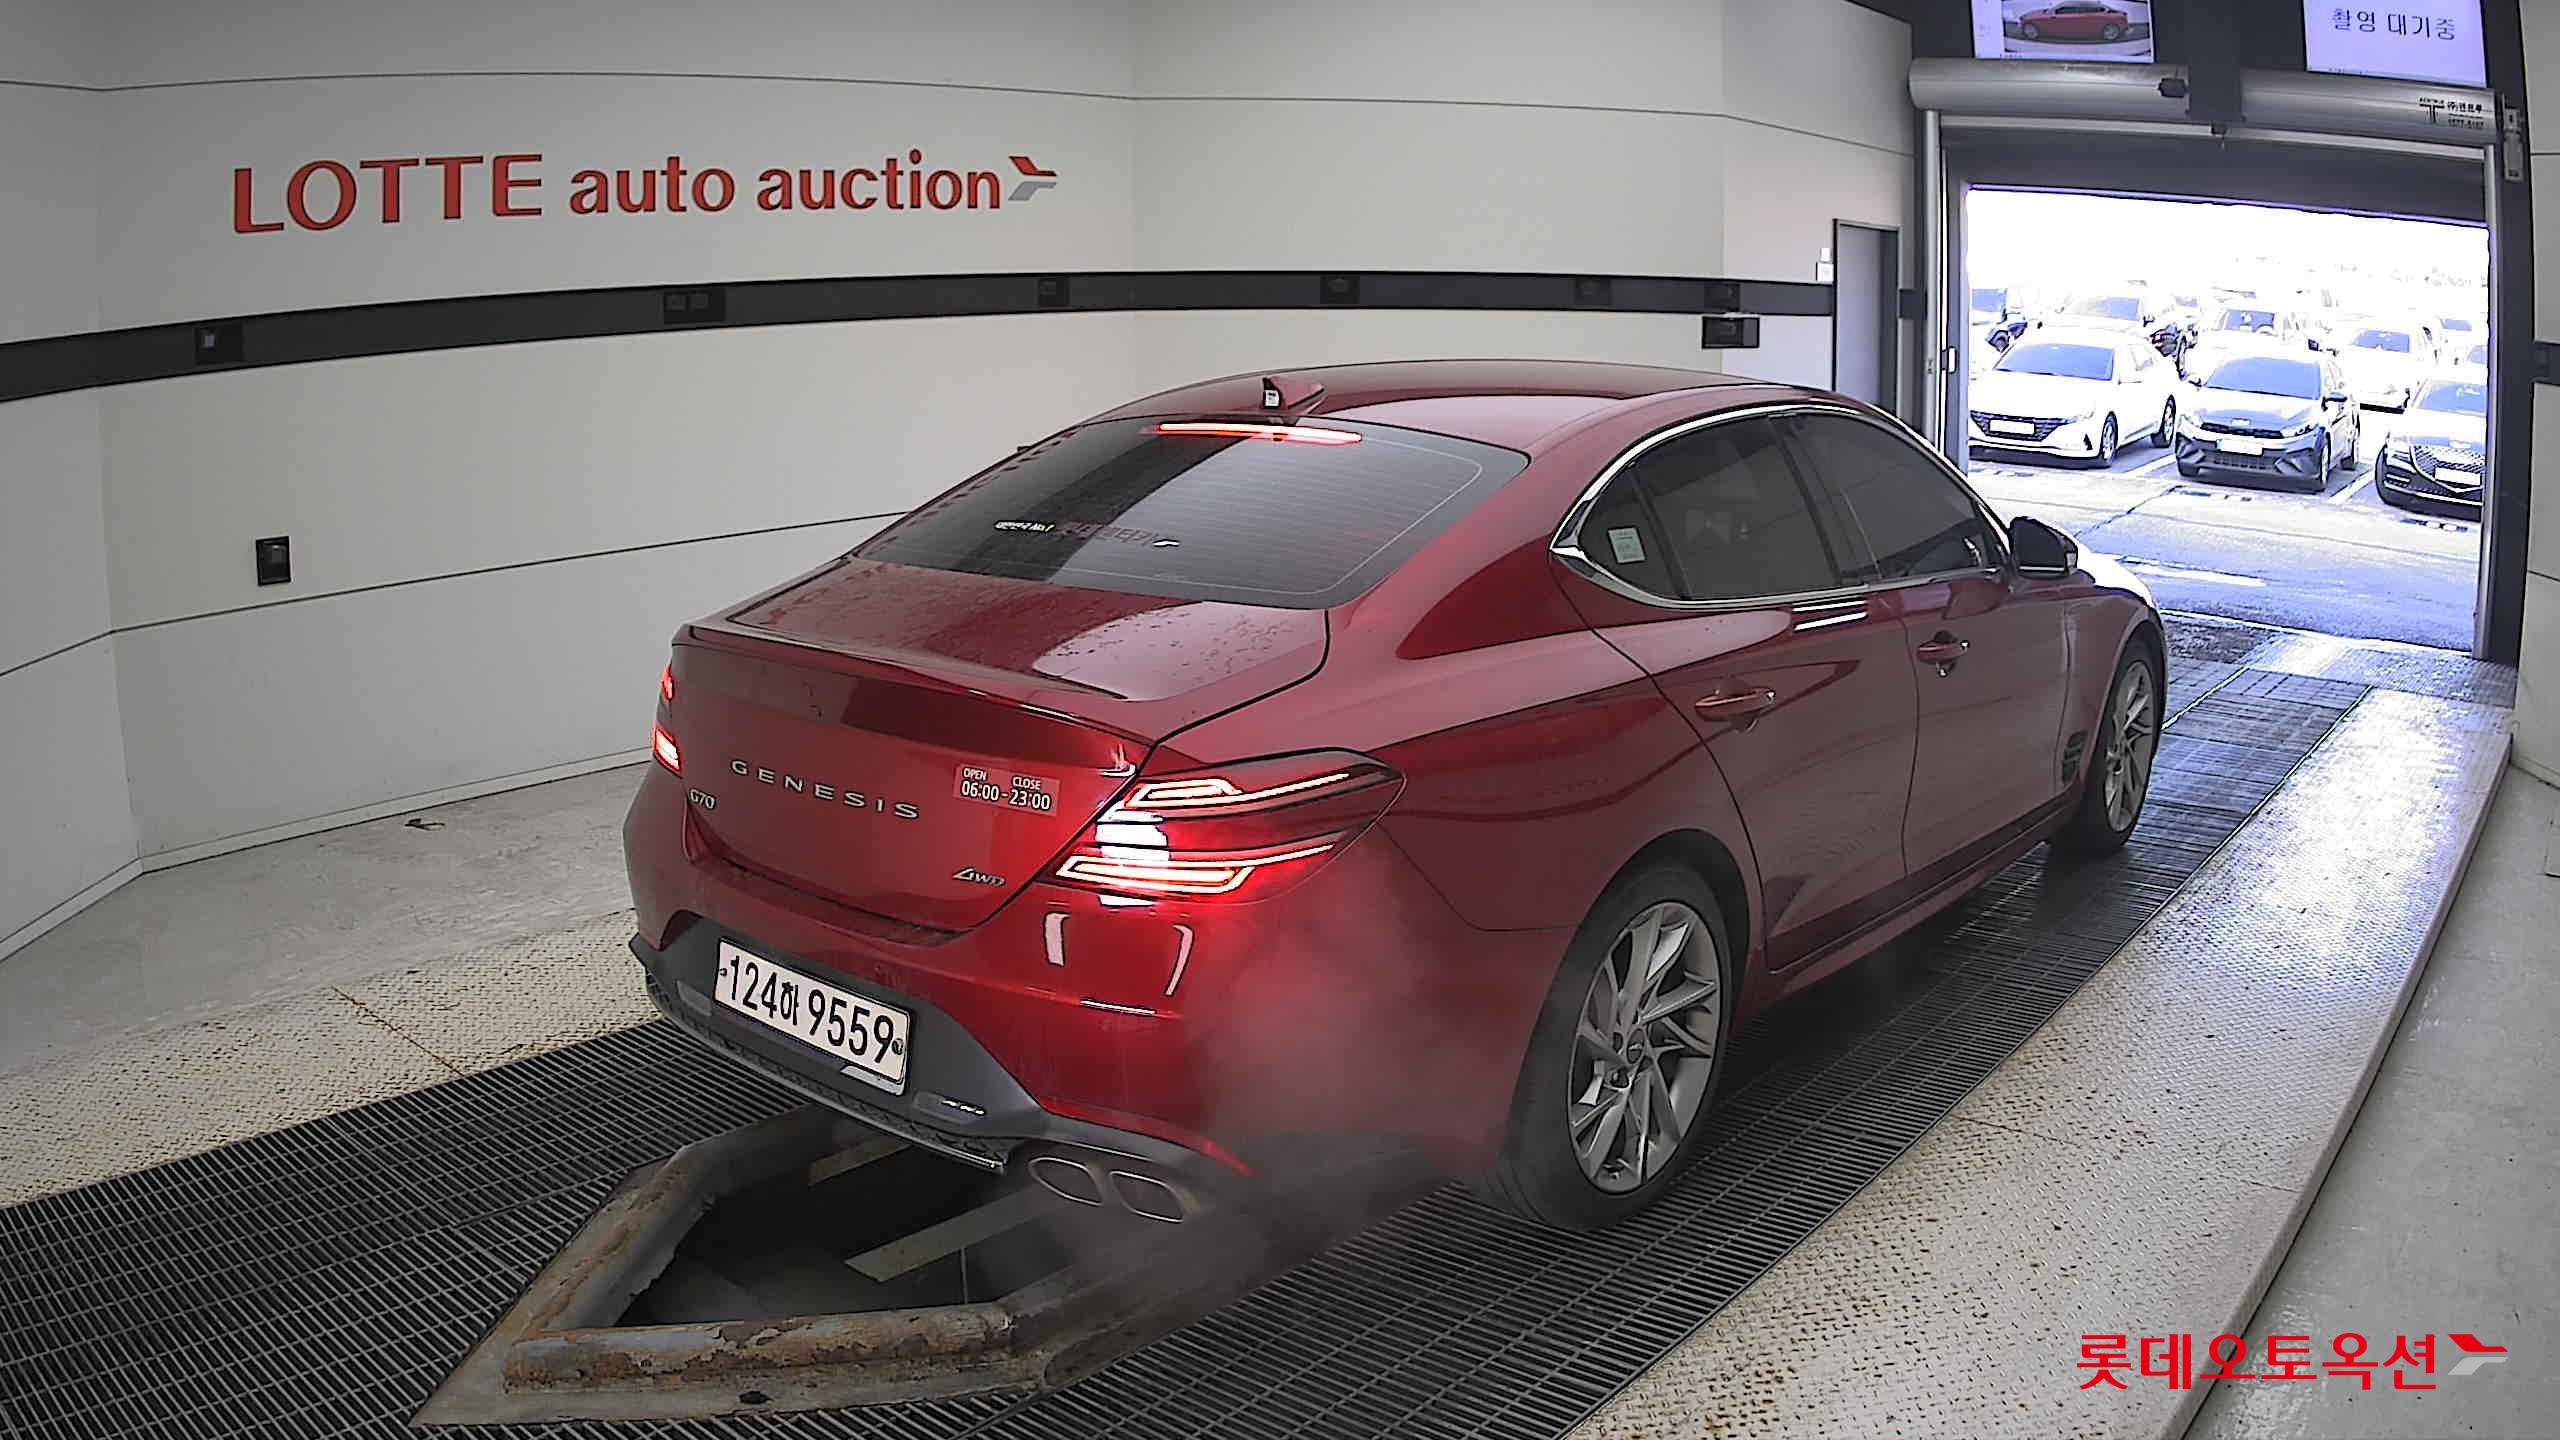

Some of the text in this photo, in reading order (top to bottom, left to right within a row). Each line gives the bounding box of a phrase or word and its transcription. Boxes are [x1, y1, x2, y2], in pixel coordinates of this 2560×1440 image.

[2333, 8, 2456, 41] 촬영 대기중
[234, 149, 1001, 234] LOTTE auto auction
[731, 760, 919, 819] GENESIS
[963, 767, 1041, 790] OPEN CLOSE
[689, 788, 716, 809] G70
